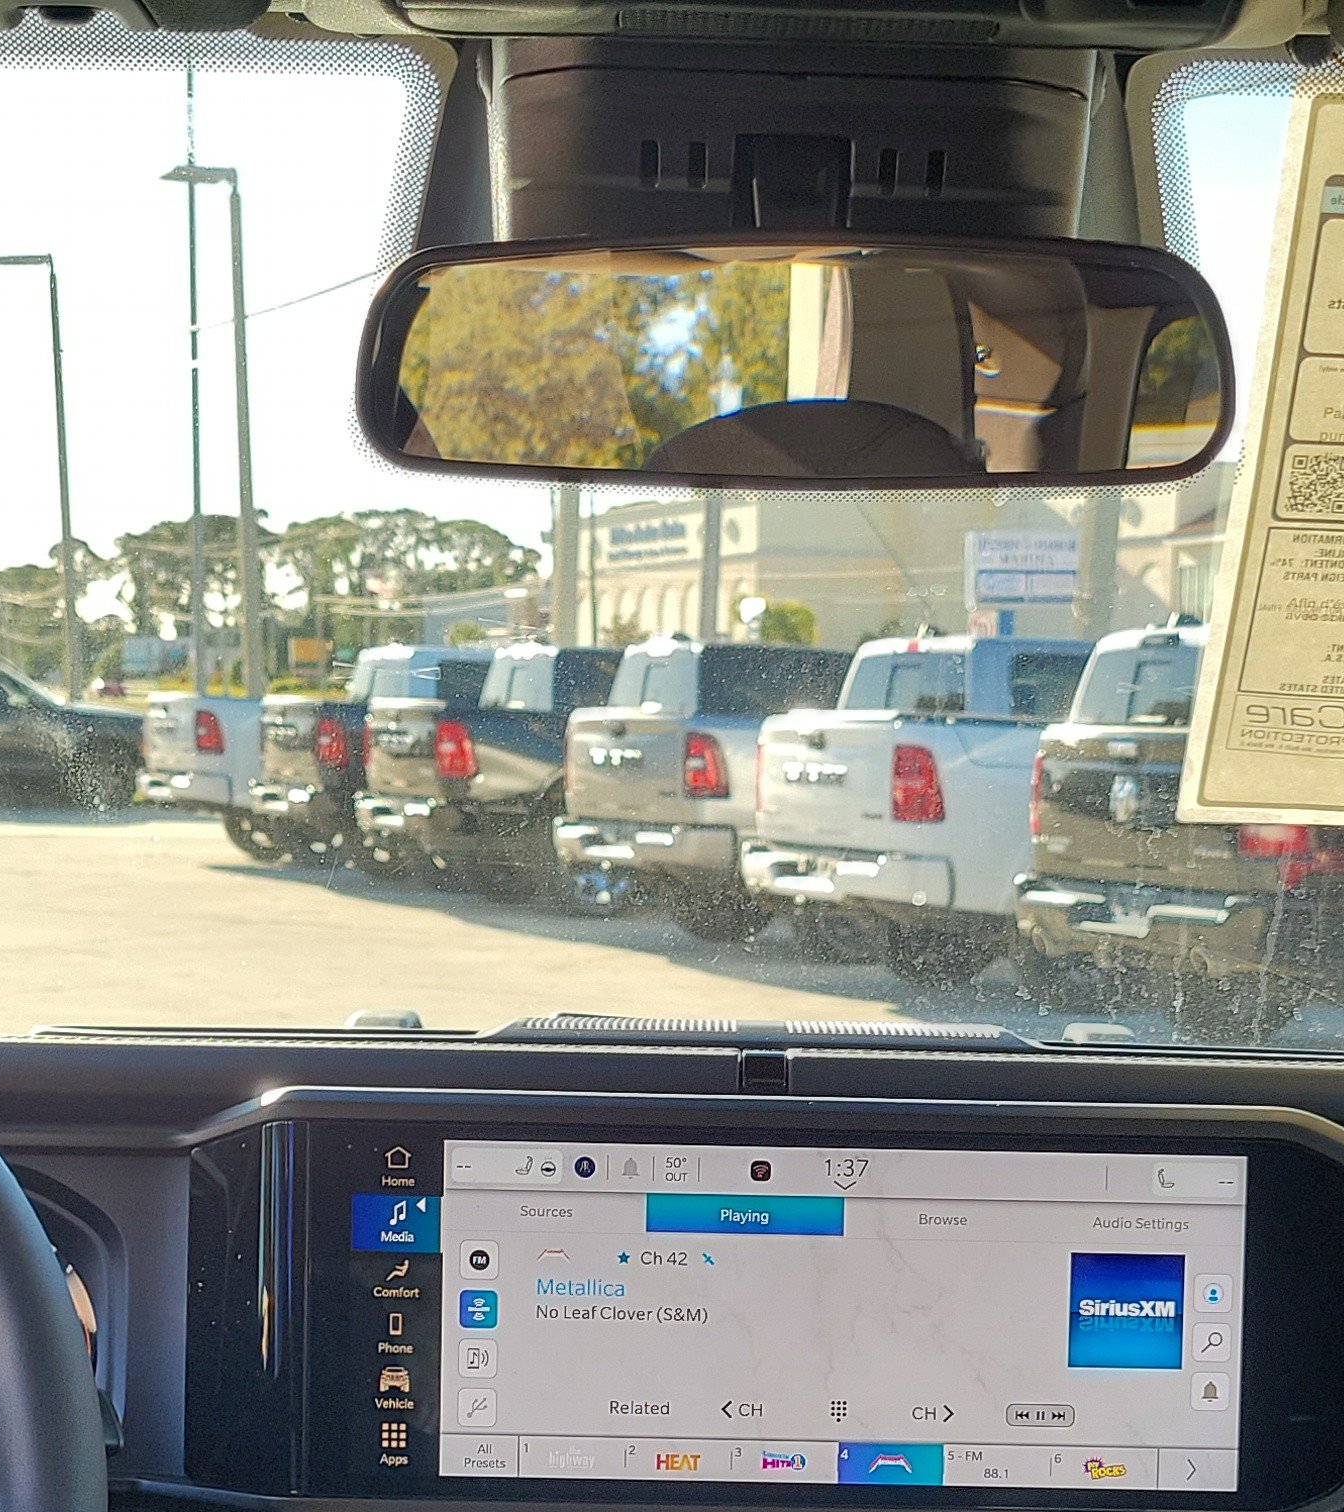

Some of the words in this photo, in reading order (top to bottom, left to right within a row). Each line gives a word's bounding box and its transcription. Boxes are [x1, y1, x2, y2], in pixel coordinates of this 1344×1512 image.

[825, 1159, 869, 1178] 1:37
[382, 1176, 416, 1187] Home
[665, 1173, 688, 1182] OUT
[520, 1205, 573, 1218] Sources
[720, 1210, 769, 1225] Playing
[918, 1213, 968, 1227] Browse
[1093, 1217, 1131, 1231] Audio
[1135, 1217, 1190, 1233] Settings
[381, 1231, 415, 1243] Media
[641, 1252, 663, 1266] Ch
[666, 1252, 688, 1266] 42
[373, 1287, 420, 1299] Comfort
[537, 1278, 626, 1297] Metallica
[536, 1305, 560, 1320] No
[563, 1305, 596, 1320] Leaf
[600, 1306, 654, 1322] Clover
[656, 1307, 709, 1324] (S&M)
[1078, 1298, 1176, 1318] SiriusXM
[378, 1342, 414, 1354] Phone
[375, 1398, 414, 1410] Vehicle
[609, 1400, 670, 1416] Related
[738, 1403, 763, 1417] CH
[912, 1407, 936, 1421] CH
[477, 1444, 492, 1455] All
[379, 1454, 409, 1467] Apps
[464, 1458, 506, 1469] Presets
[656, 1453, 701, 1471] HEAT
[984, 1469, 1009, 1479] 88.1
